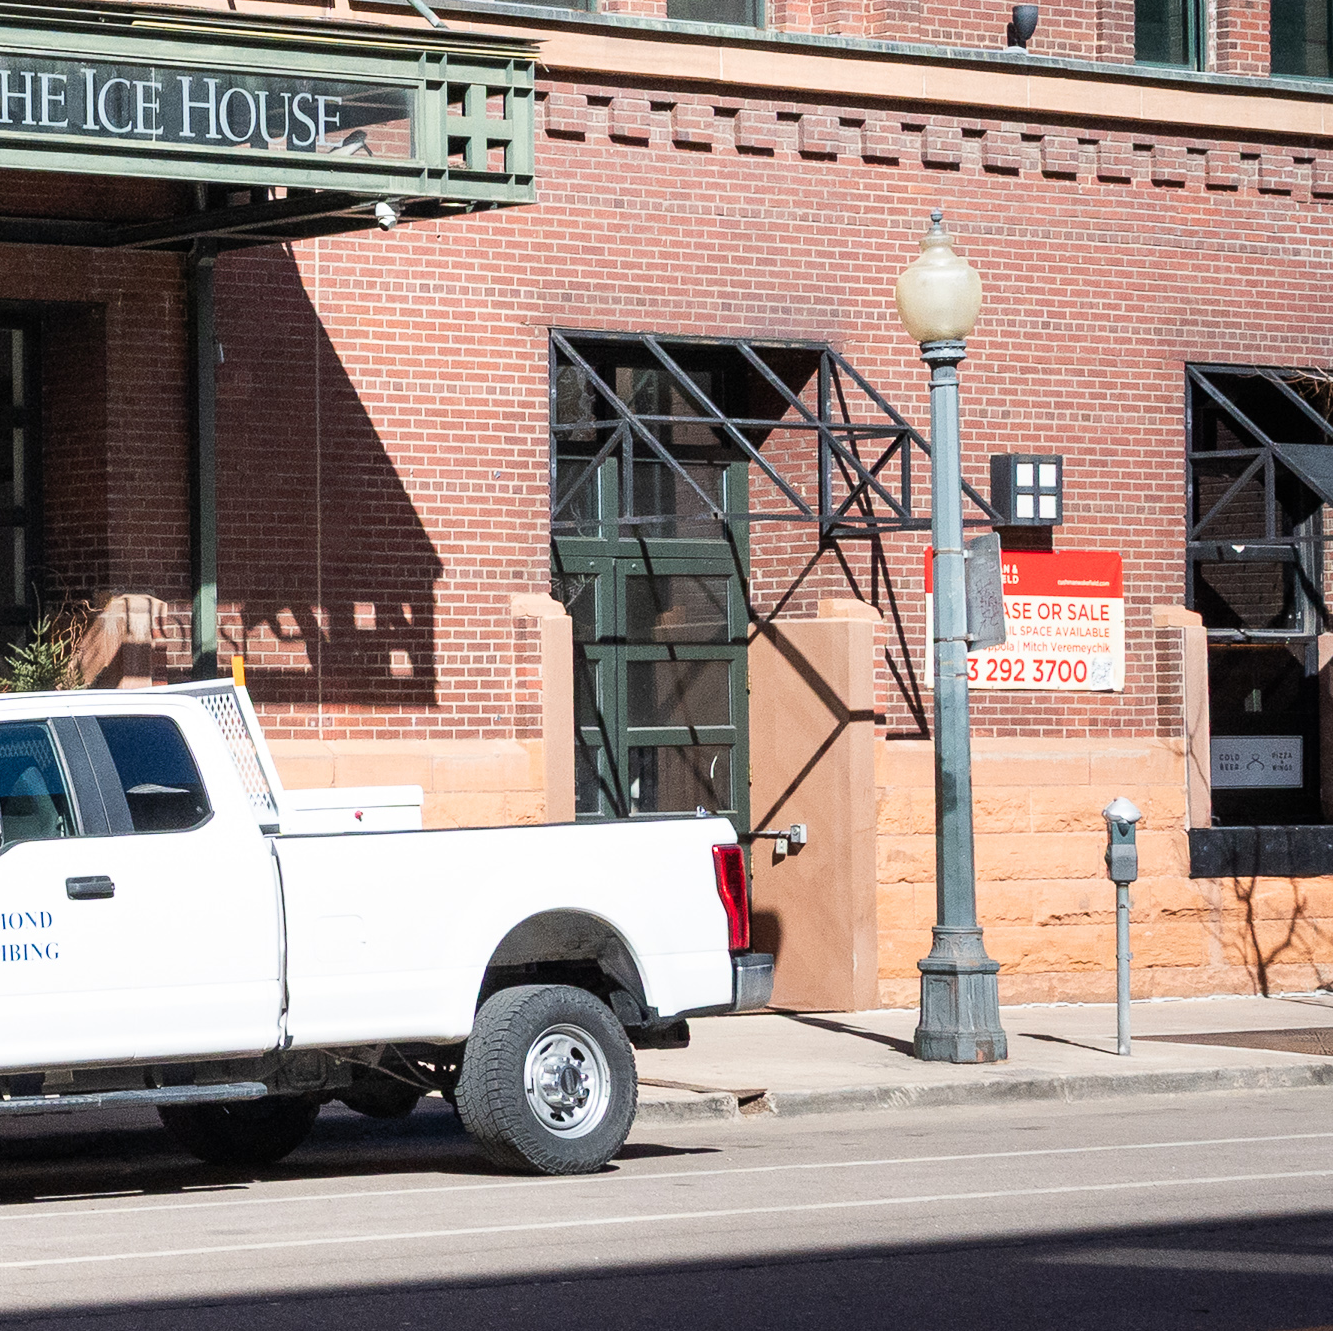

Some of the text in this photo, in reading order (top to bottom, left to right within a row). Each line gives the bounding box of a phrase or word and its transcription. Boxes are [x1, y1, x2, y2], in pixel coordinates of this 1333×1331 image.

[81, 67, 164, 135] ICE
[176, 74, 344, 149] HOUSE
[1004, 602, 1110, 621] ASE OR SALE
[1020, 626, 1052, 637] SPACE
[1055, 627, 1110, 638] AVAILABLE
[1023, 641, 1048, 652] Mitch
[986, 658, 1026, 682] 292
[1032, 659, 1087, 683] 3700
